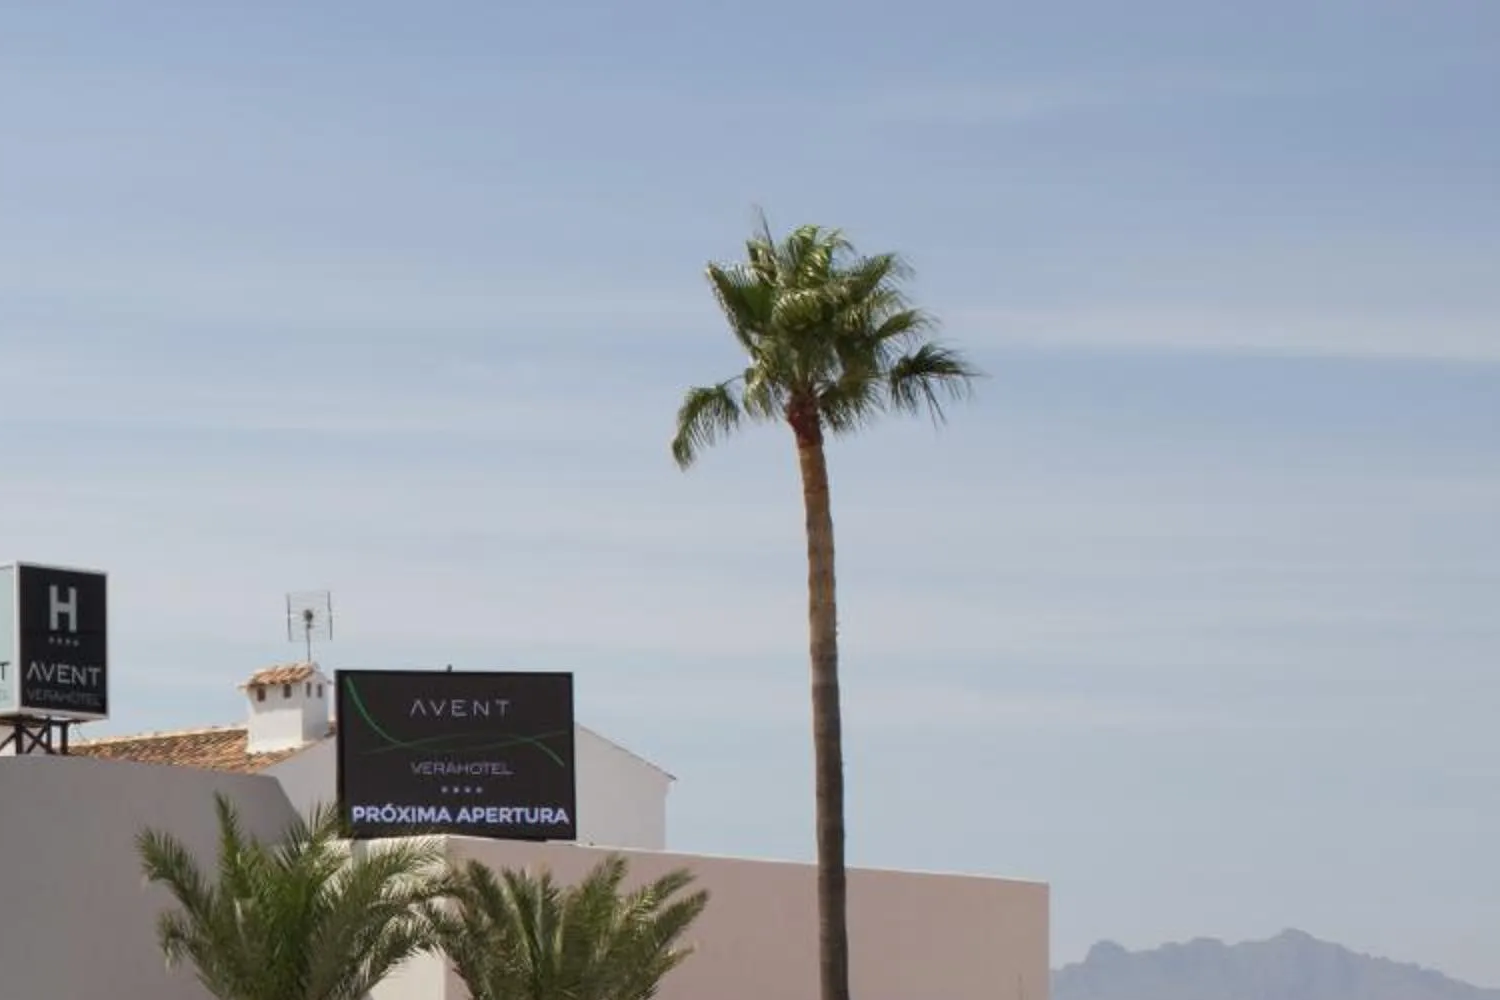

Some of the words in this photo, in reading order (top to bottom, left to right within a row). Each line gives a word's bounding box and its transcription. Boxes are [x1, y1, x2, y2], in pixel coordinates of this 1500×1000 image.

[49, 585, 77, 633] H
[26, 661, 101, 687] AVENT
[410, 700, 510, 717] AVENT
[410, 761, 513, 775] VERAHOTEL
[352, 803, 452, 823] PRÓXIMA
[456, 807, 569, 824] APERTURA
